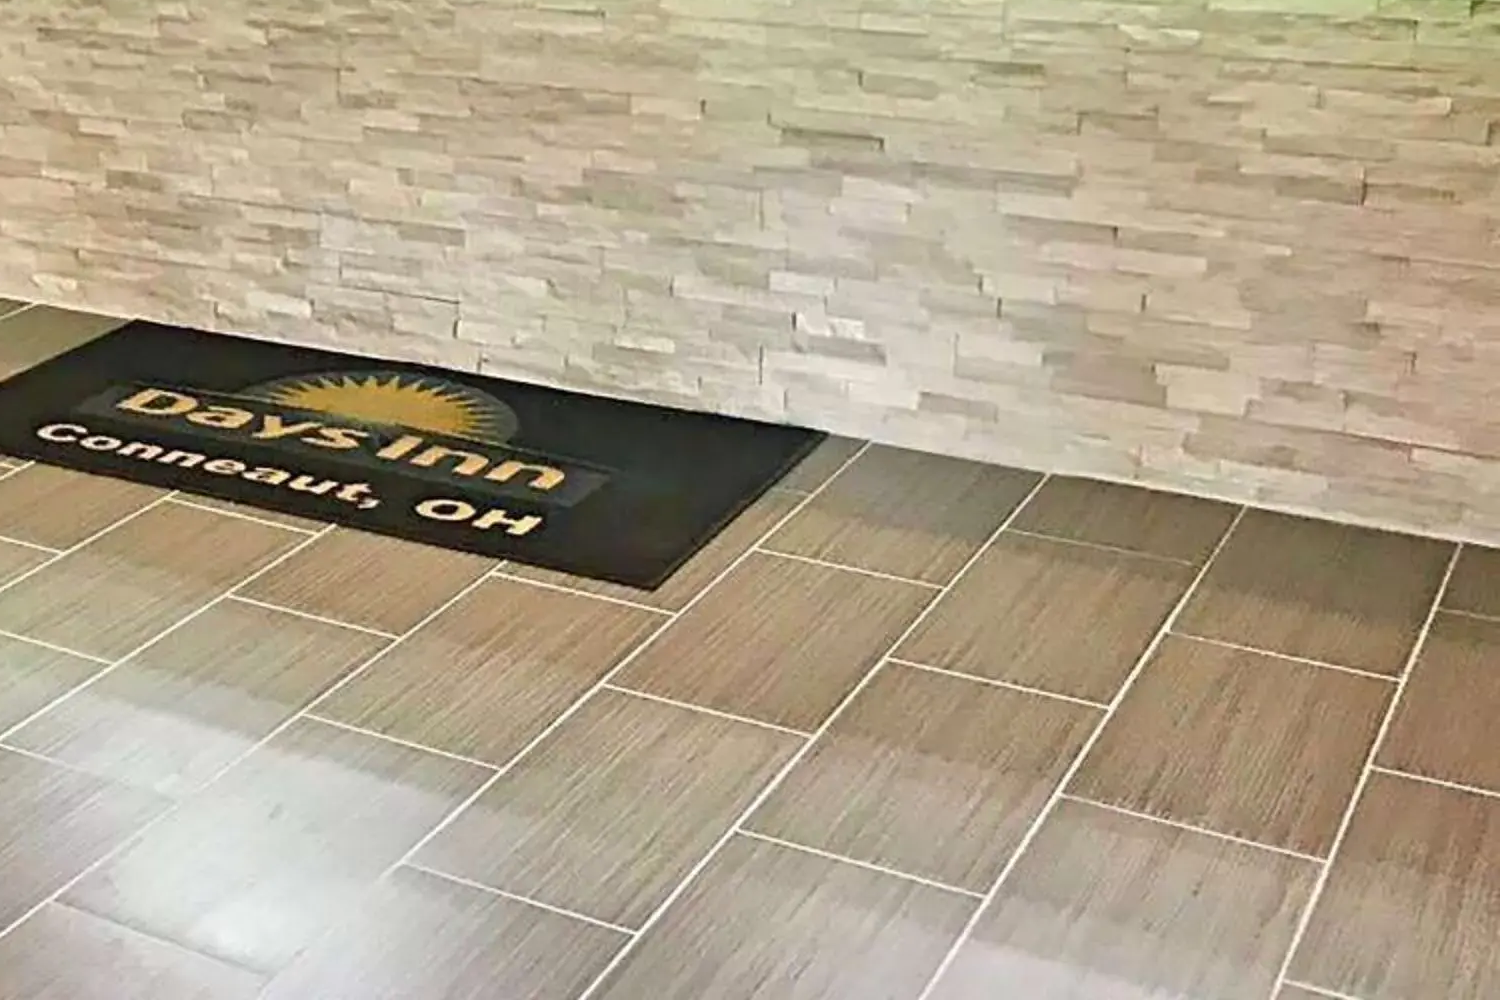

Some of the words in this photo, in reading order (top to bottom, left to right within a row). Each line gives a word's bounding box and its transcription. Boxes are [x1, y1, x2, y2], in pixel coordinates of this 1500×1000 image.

[35, 422, 380, 511] Conneaut,
[414, 498, 544, 537] OH
[116, 388, 372, 450] Days
[376, 434, 566, 492] Inn
